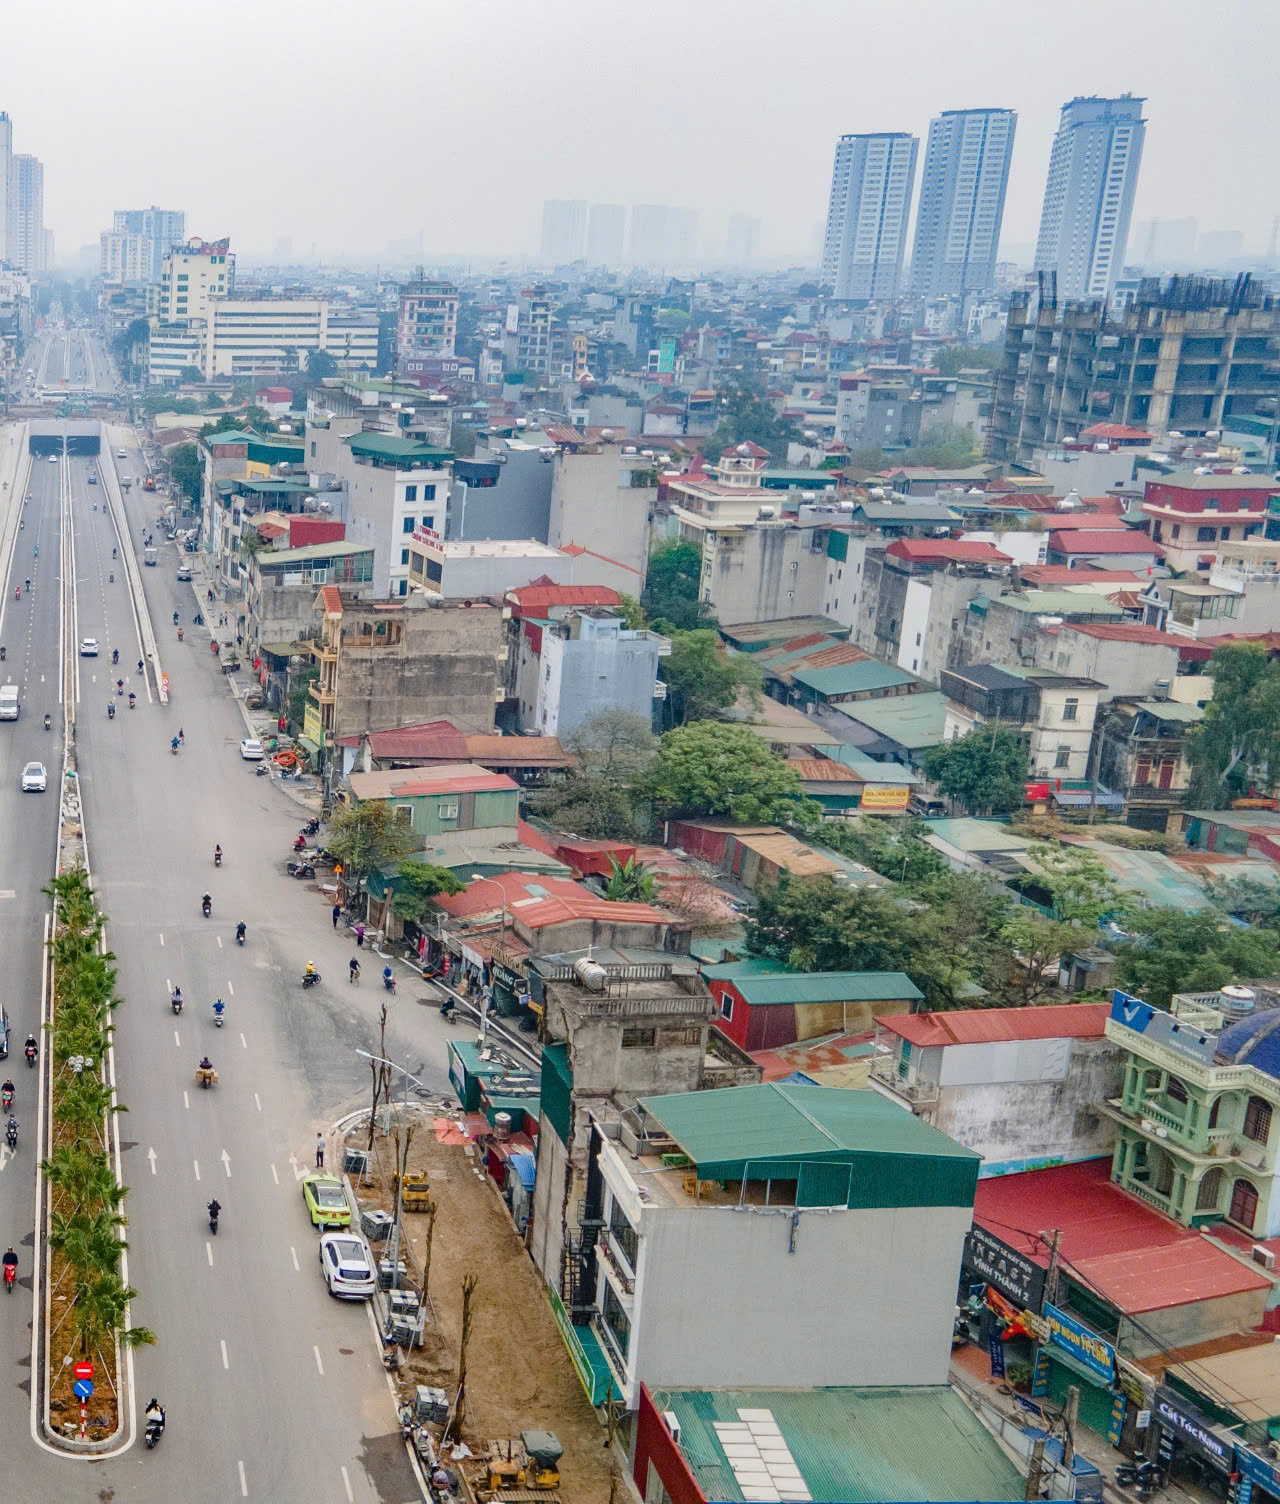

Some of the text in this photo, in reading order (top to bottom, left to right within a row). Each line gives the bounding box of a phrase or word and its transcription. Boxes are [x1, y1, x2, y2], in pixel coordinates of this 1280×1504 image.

[1023, 1292, 1030, 1302] 2
[1179, 1416, 1198, 1437] Tóc
[1198, 1431, 1224, 1456] Nam
